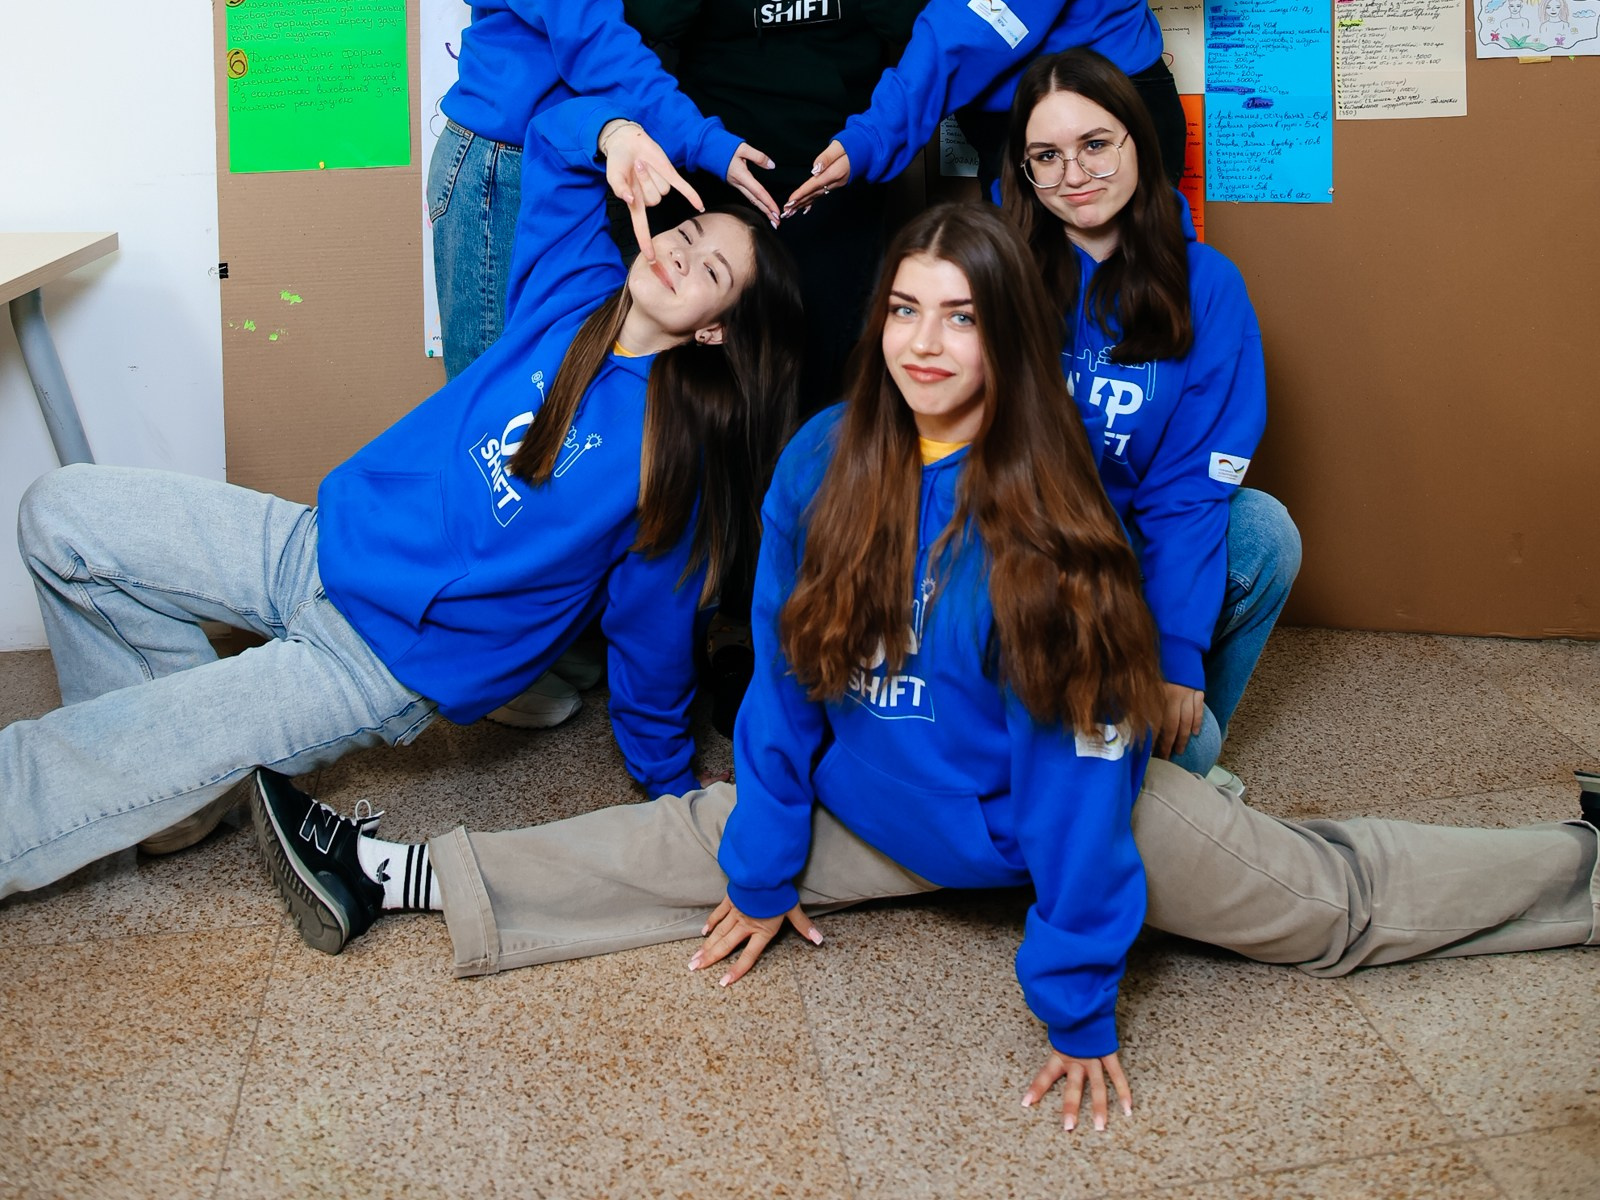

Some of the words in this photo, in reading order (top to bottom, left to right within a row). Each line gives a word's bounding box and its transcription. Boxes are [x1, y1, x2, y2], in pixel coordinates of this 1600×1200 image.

[257, 22, 268, 30] не
[230, 50, 246, 76] 6
[481, 438, 521, 509] SHIFT
[848, 667, 926, 707] SHIFT
